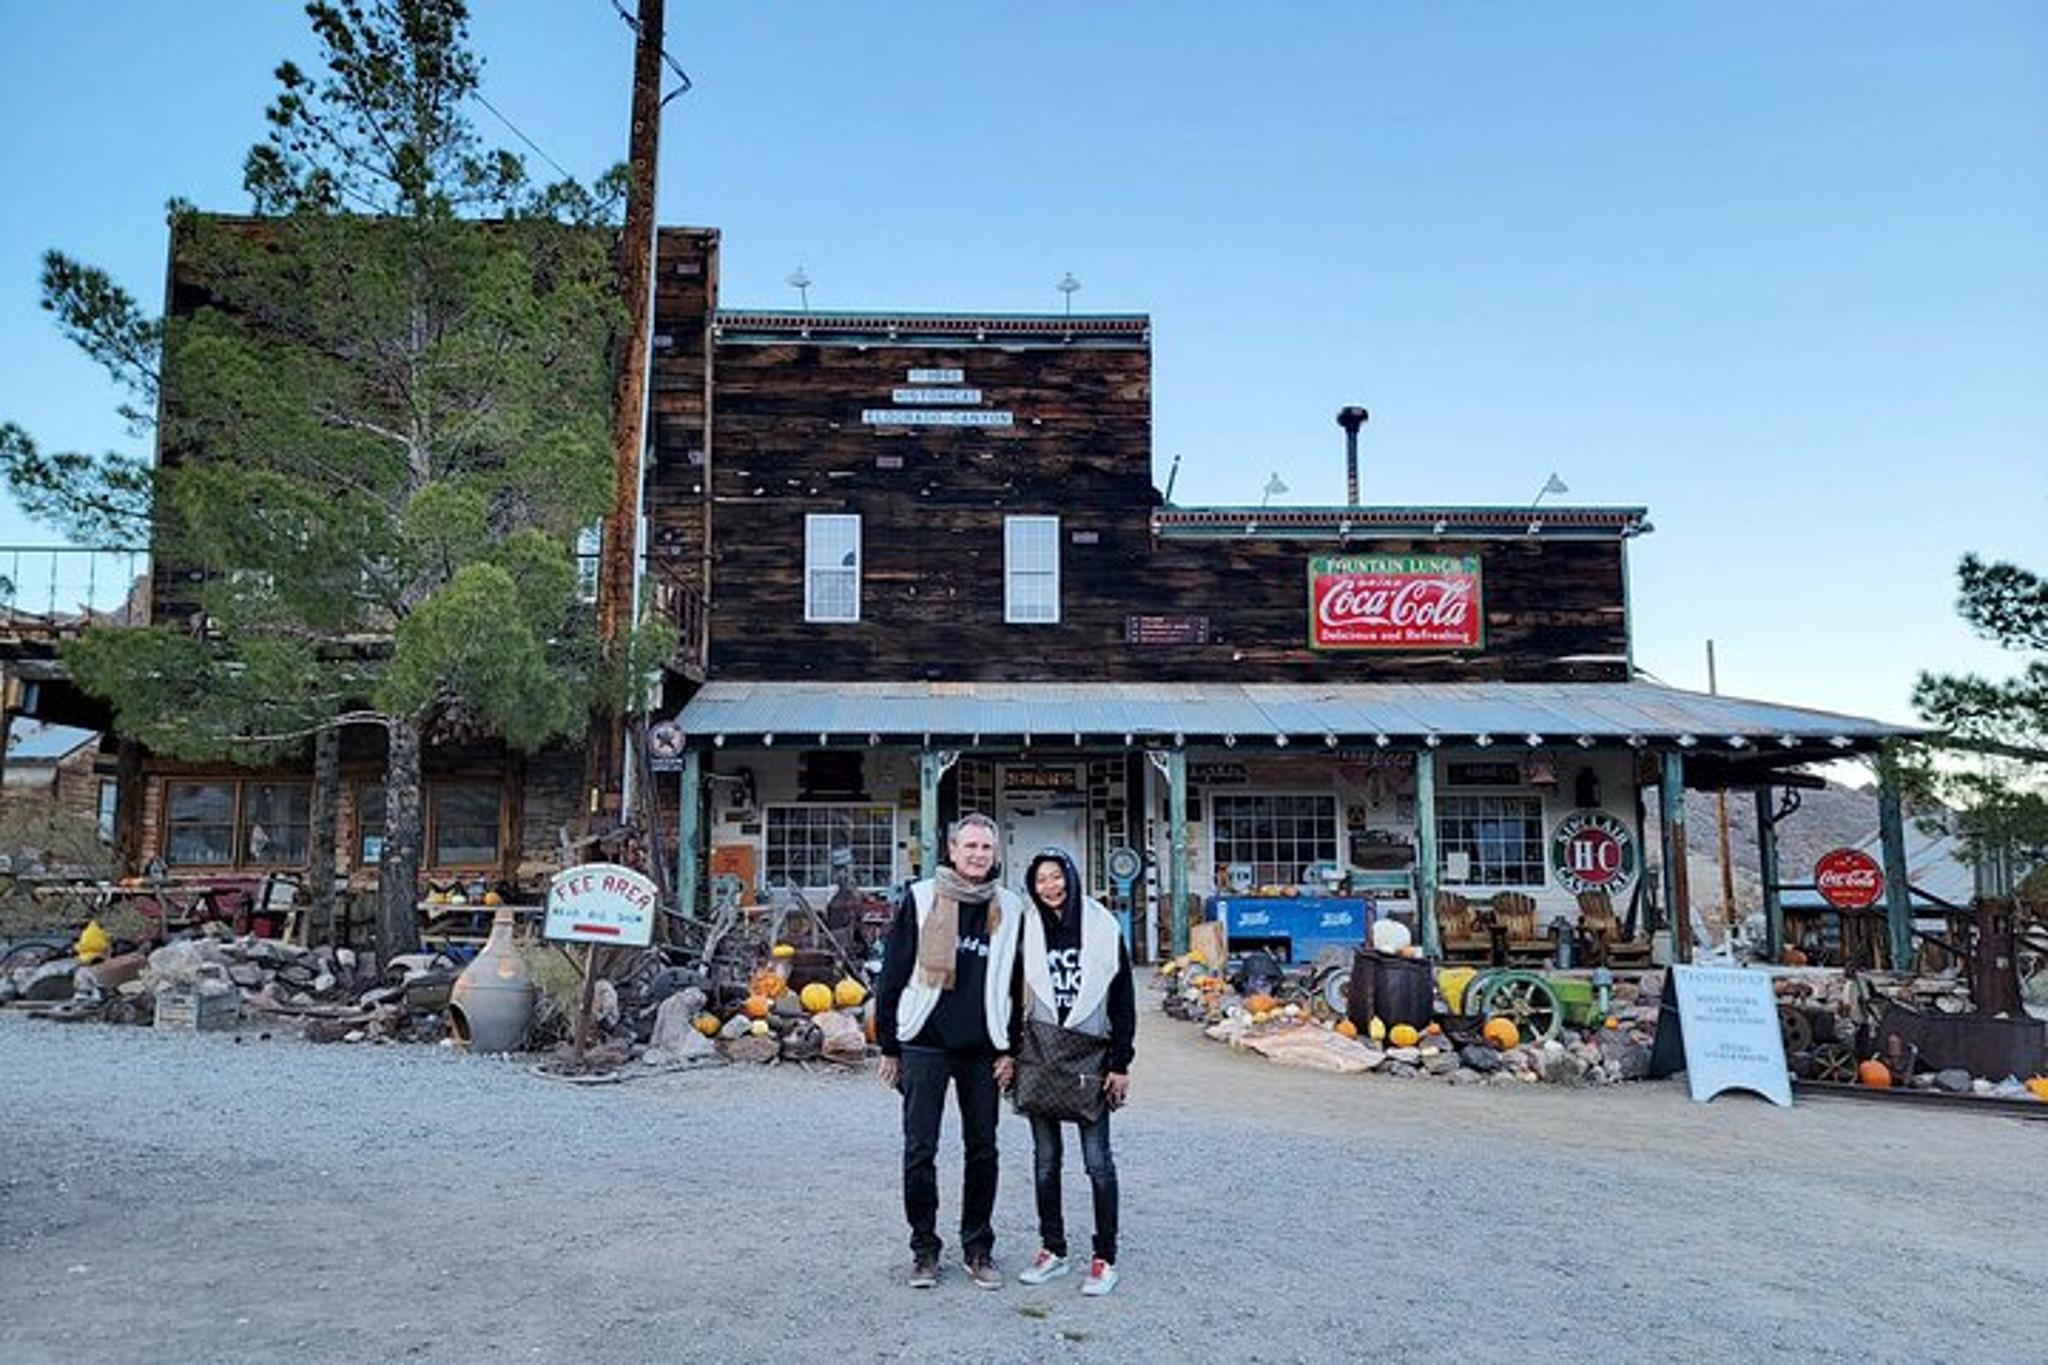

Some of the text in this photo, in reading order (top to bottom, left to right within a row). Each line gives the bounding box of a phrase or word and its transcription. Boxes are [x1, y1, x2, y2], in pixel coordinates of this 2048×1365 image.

[1327, 557, 1402, 574] FOUNTAIN
[1321, 629, 1470, 644] Delicious and Refreshing
[1556, 815, 1629, 843] SINCLAIR
[555, 874, 652, 911] FEE AREA
